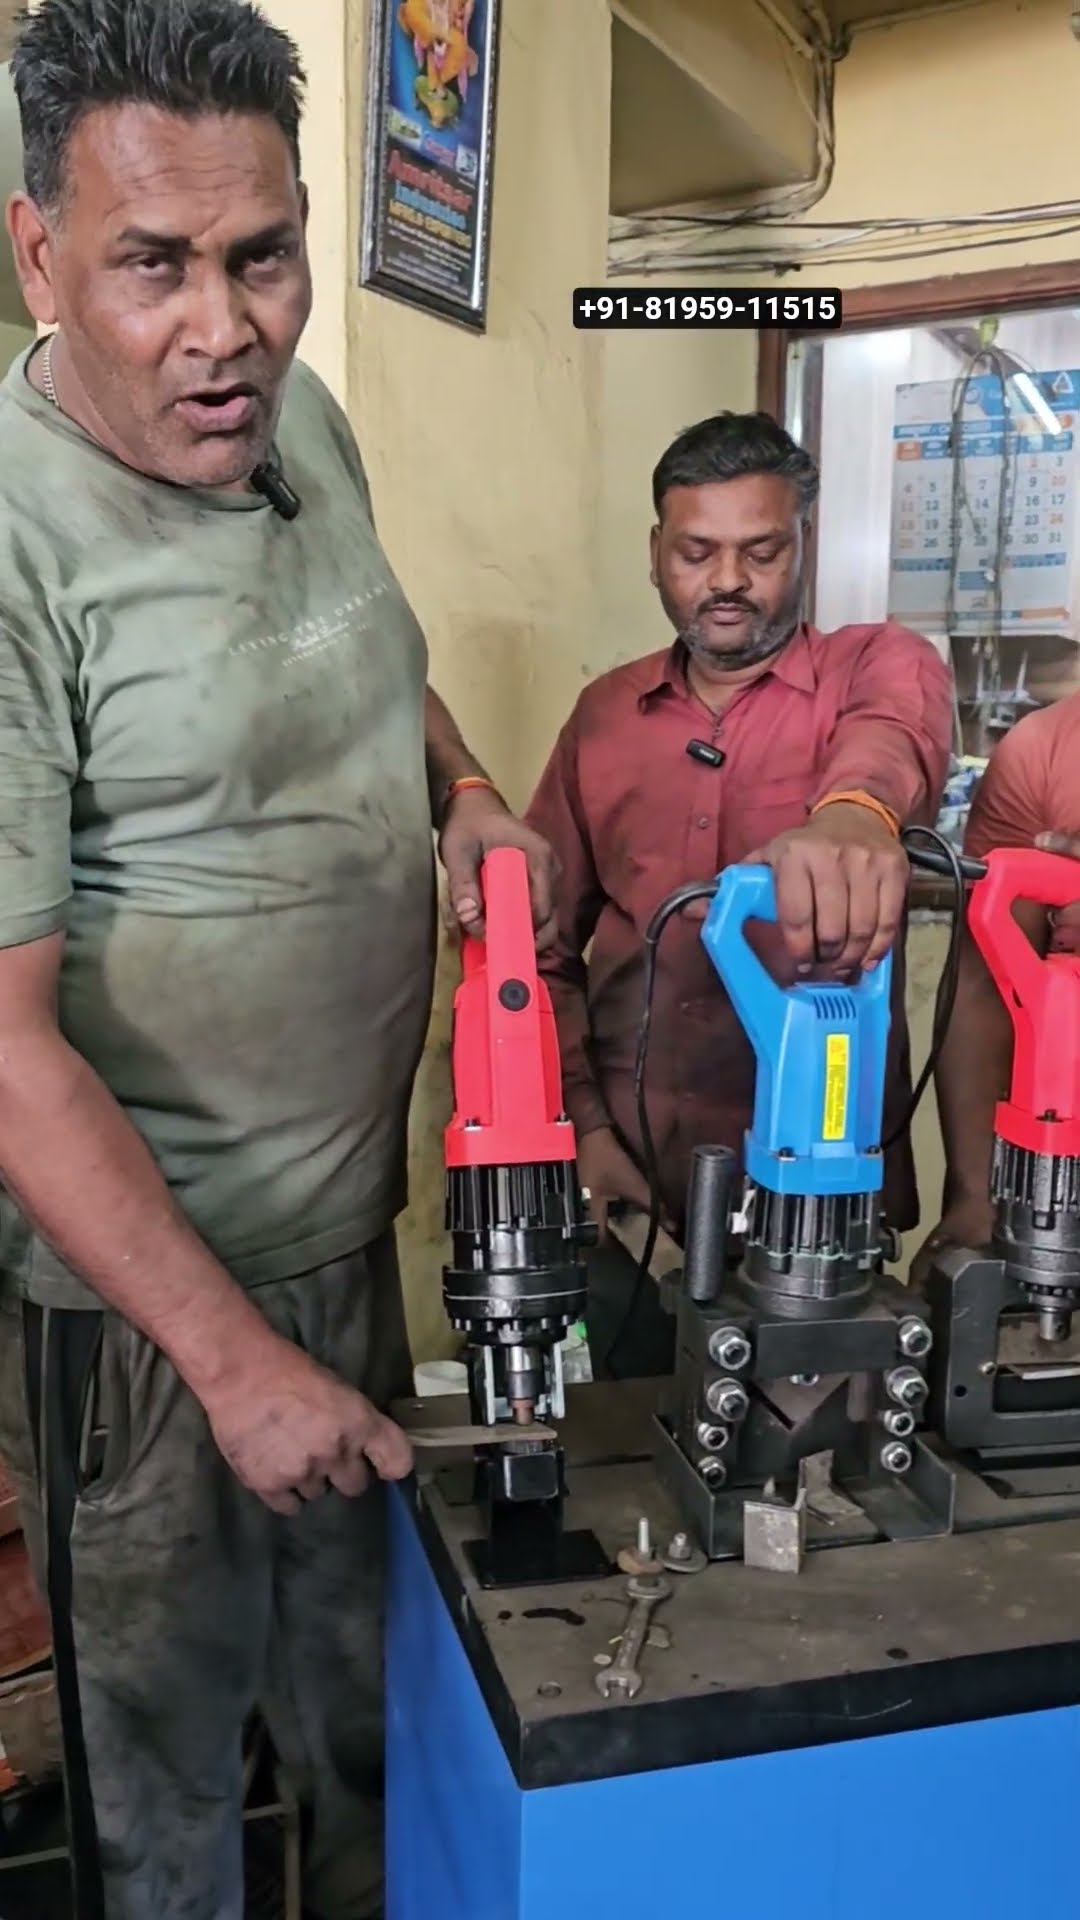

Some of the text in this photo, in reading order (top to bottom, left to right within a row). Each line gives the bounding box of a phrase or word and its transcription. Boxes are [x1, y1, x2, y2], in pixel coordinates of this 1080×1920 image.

[387, 149, 473, 213] Amritsar
[1029, 476, 1038, 488] 9
[925, 500, 939, 511] 12
[1024, 495, 1040, 507] 16
[1050, 493, 1066, 505] 17
[1023, 514, 1039, 526] 23
